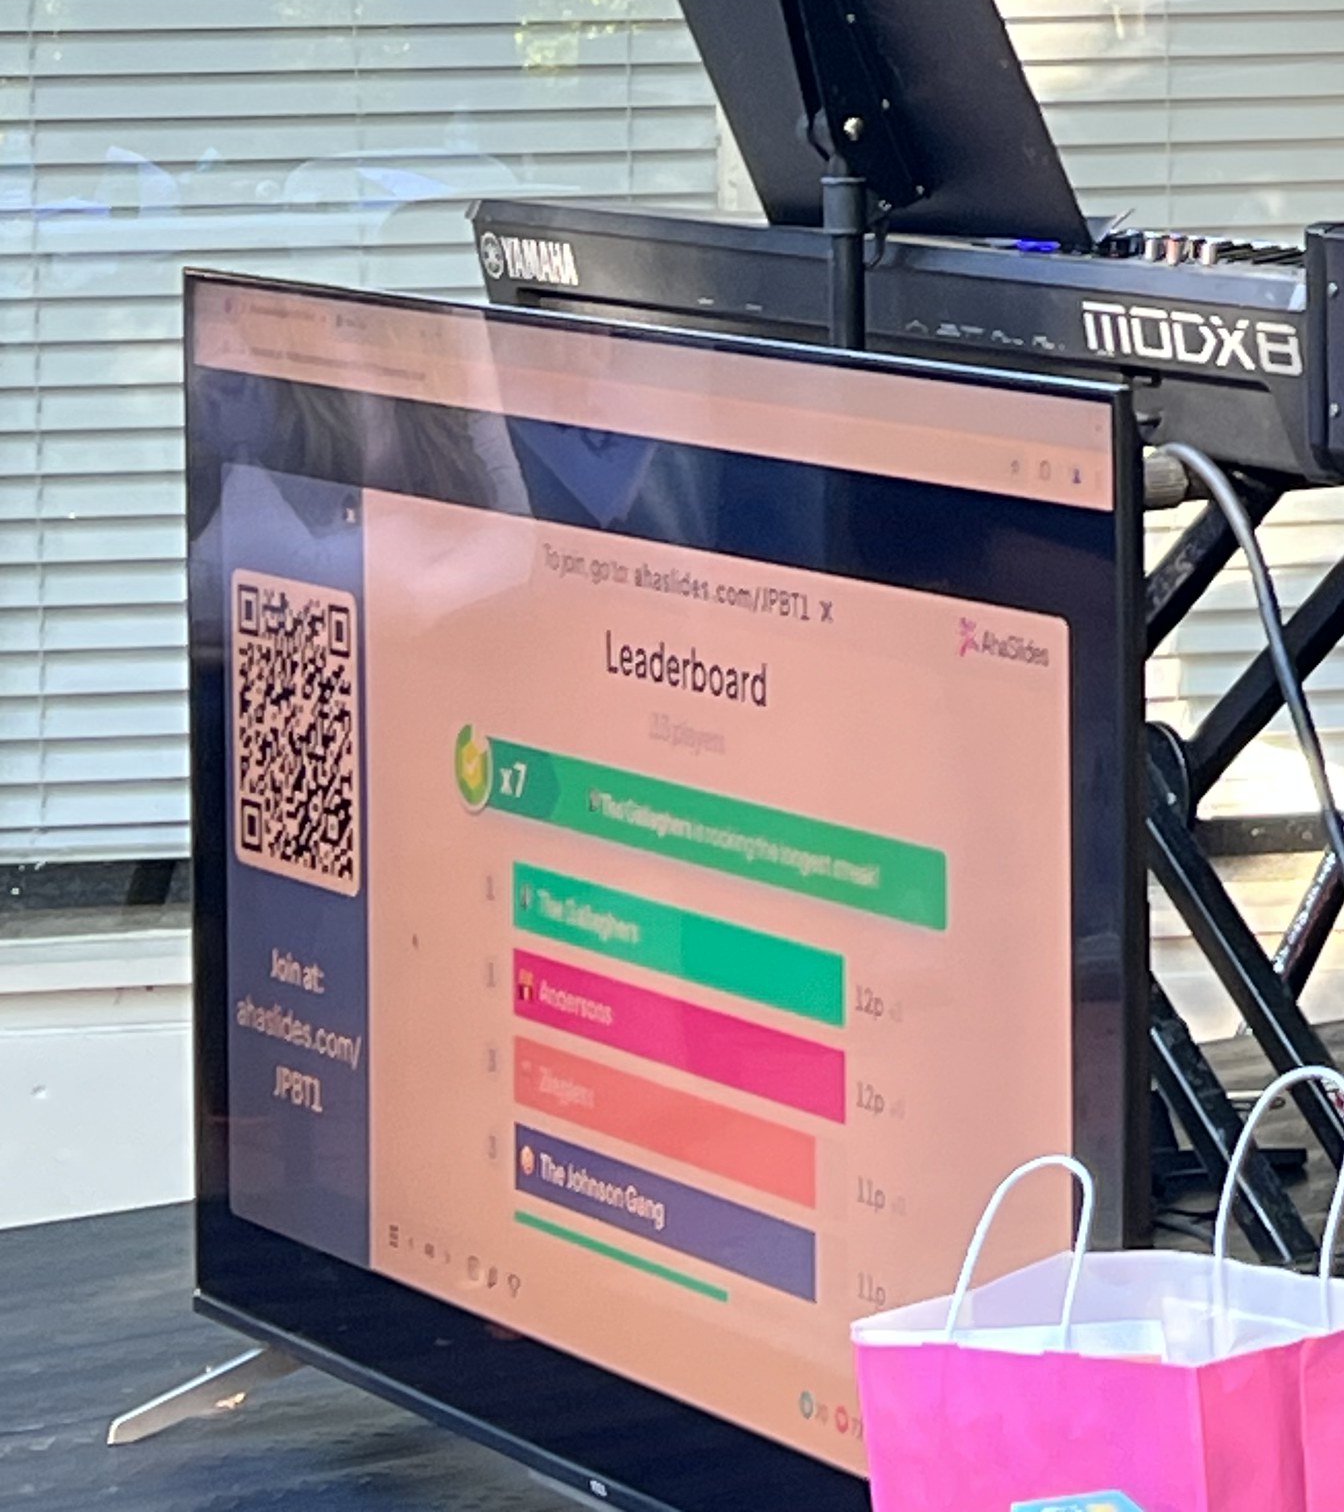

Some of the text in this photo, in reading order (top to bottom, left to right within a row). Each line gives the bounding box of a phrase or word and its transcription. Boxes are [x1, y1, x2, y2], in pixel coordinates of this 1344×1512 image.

[500, 235, 579, 287] YAMAHA
[1082, 300, 1303, 376] MODX8
[605, 628, 769, 708] Leaderboard
[499, 761, 528, 798] x7
[270, 947, 301, 986] Join
[236, 994, 363, 1071] ahaslides.com/
[272, 1064, 324, 1113] JPBT1
[540, 1152, 666, 1232] The Johnson Gang
